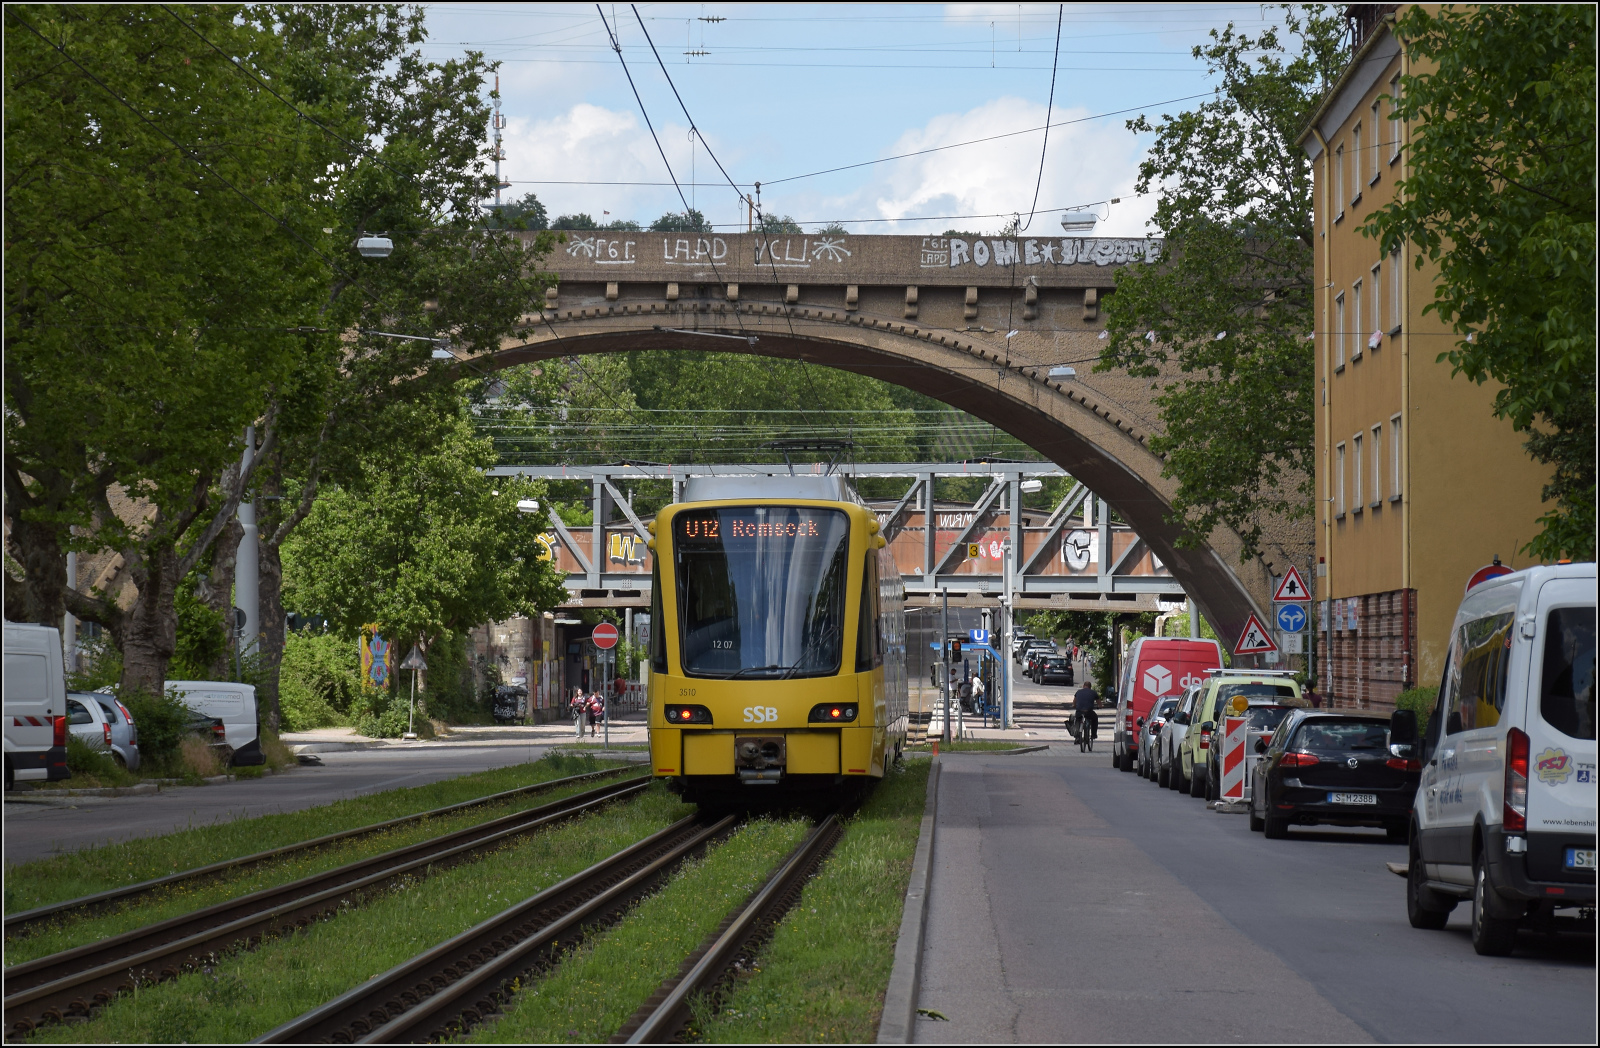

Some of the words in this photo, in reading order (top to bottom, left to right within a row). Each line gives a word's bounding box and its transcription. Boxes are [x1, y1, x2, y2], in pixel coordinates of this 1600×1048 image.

[686, 520, 719, 538] U12
[969, 545, 979, 557] 3
[973, 629, 985, 641] U
[679, 688, 697, 697] 3510
[743, 705, 779, 724] SSB
[1538, 755, 1568, 771] FSJ
[1542, 818, 1597, 827] www.lebenshil
[1576, 851, 1585, 865] S
